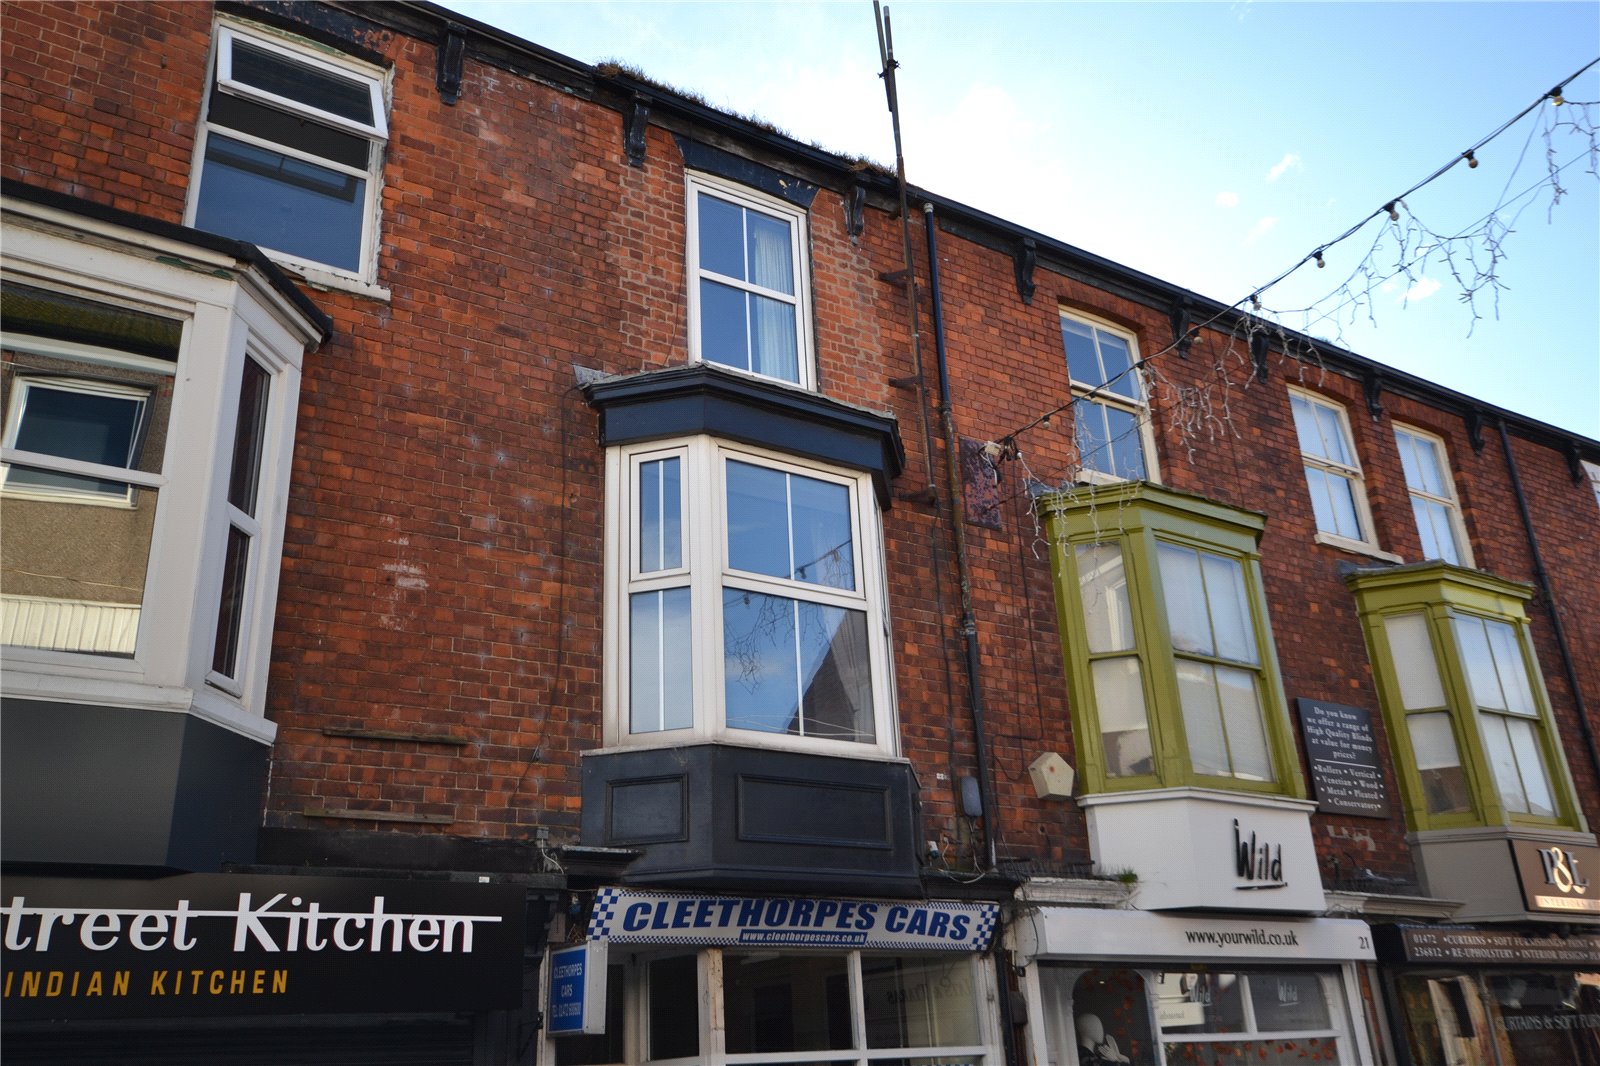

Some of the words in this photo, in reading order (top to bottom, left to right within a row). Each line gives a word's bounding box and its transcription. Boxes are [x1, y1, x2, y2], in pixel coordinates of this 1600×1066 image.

[1314, 706, 1325, 715] Do
[1327, 710, 1338, 718] you
[1340, 711, 1357, 720] know
[1319, 717, 1335, 727] offer
[1343, 722, 1360, 731] range
[1362, 724, 1369, 732] of
[1307, 725, 1324, 736] High
[1326, 727, 1350, 740] Quality
[1352, 732, 1373, 742] Blinds
[1321, 738, 1338, 747] value
[1340, 740, 1351, 749] for
[1353, 744, 1373, 754] money
[1350, 768, 1376, 779] Vertical
[1323, 775, 1352, 786] Venetian
[1360, 780, 1378, 790] Wood
[1327, 786, 1347, 796] Metal
[1354, 789, 1378, 800] Pleated
[1334, 798, 1378, 811] Conservatory
[1233, 817, 1283, 882] Wild
[233, 892, 476, 953] Kitchen
[622, 900, 876, 932] CLEETHORPES
[885, 902, 973, 942] CARS
[742, 931, 866, 944] www.cleethorpescars.co.uk
[1185, 928, 1299, 948] www.yourwild.co.uk
[1358, 936, 1370, 950] 21
[1447, 935, 1487, 946] CURTAINS
[1493, 936, 1512, 946] SOFT
[1451, 947, 1514, 959] RE-UPHOLSTERY
[1521, 949, 1558, 959] INTERIOR
[4, 971, 131, 998] INDIAN
[151, 970, 289, 996] KITCHEN
[1277, 976, 1298, 1002] Wild
